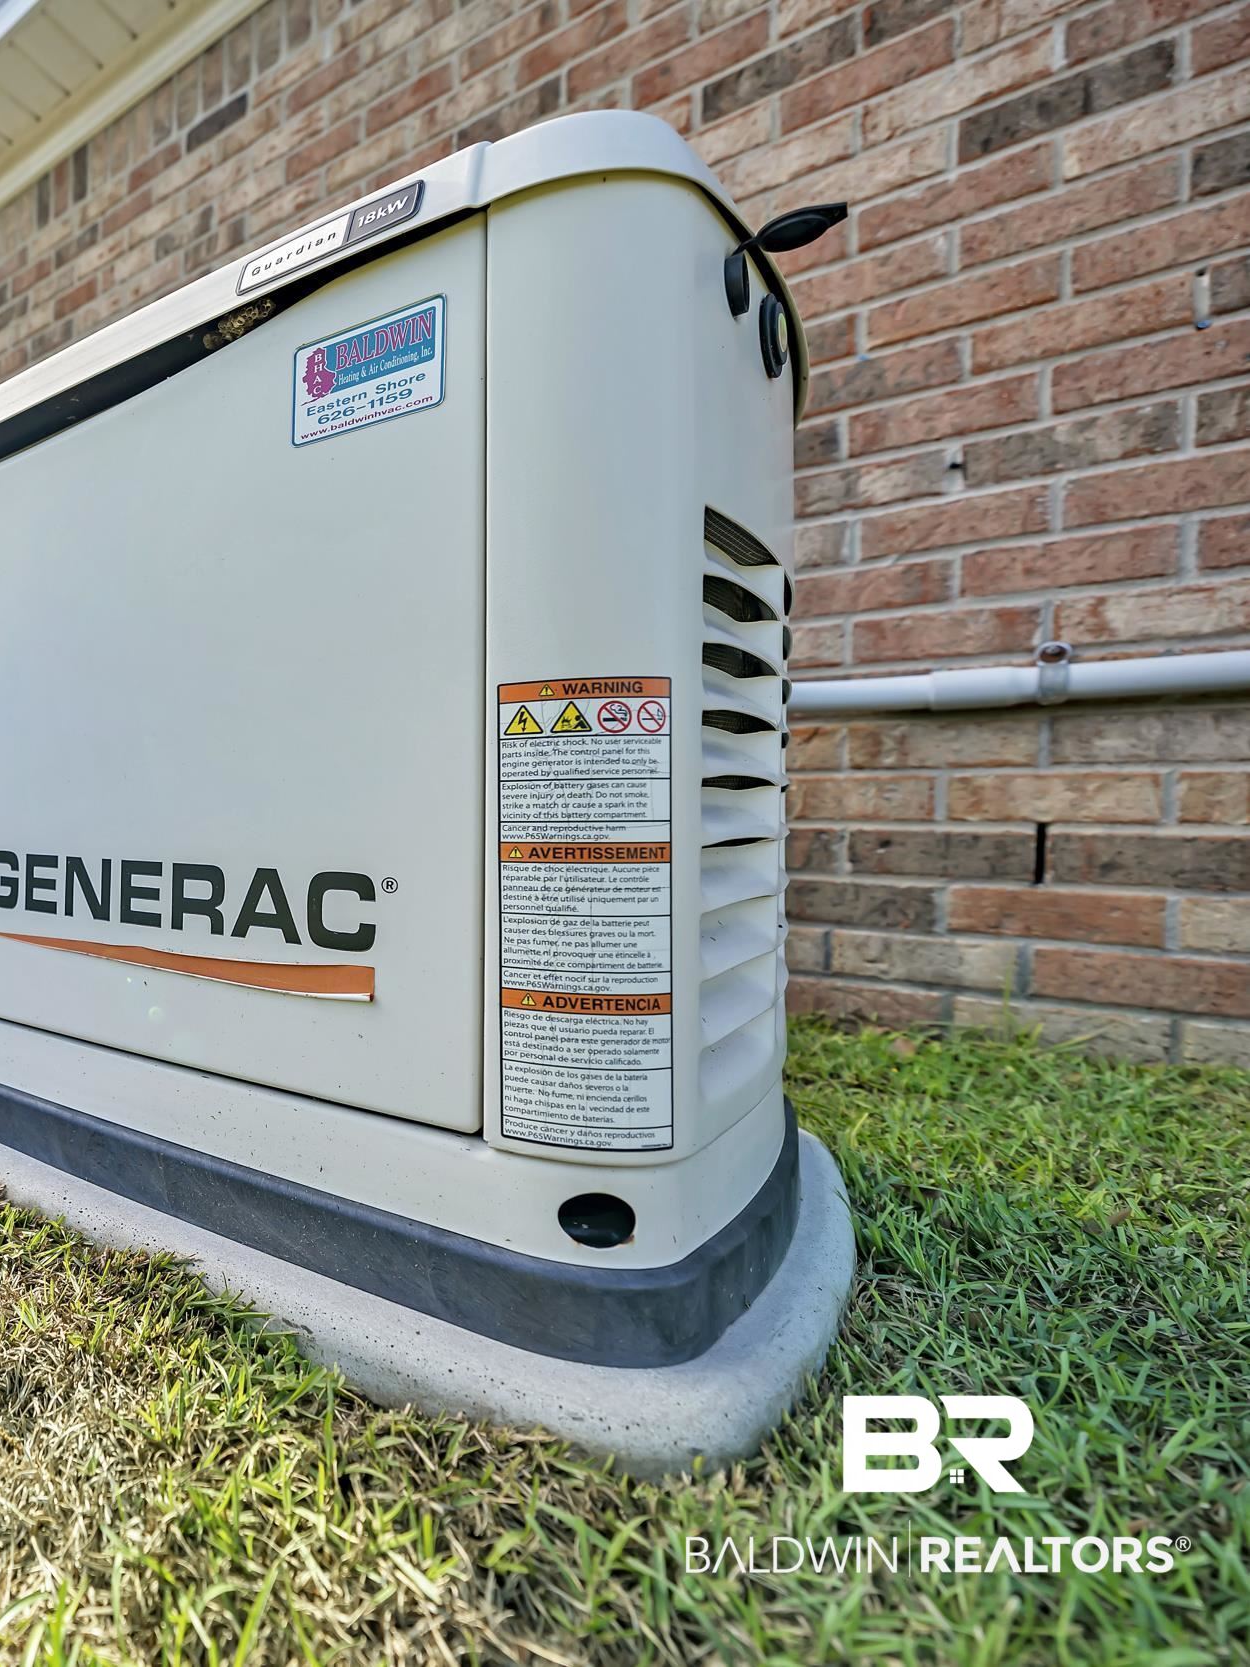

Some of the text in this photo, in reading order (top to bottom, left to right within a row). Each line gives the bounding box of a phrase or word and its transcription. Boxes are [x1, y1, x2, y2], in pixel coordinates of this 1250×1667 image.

[251, 195, 408, 276] Guardian 18kW
[335, 310, 435, 371] BALDWIN
[338, 344, 433, 386] Heating & Air Conditioning, Inc.
[306, 372, 426, 417] Eastern Shore
[317, 388, 413, 426] 626-1159
[300, 395, 433, 440] www.baldwinhvac.com
[562, 681, 643, 694] WARNING
[501, 741, 518, 749] Risk
[562, 738, 589, 746] shock.
[501, 751, 522, 760] parts
[501, 760, 530, 768] engine
[531, 759, 573, 768] generator
[501, 768, 539, 778] operated
[540, 768, 551, 776] by
[553, 767, 590, 776] qualified
[501, 783, 541, 791] Explosion
[553, 782, 585, 790] battery
[529, 792, 554, 800] injury
[532, 801, 559, 809] match
[501, 812, 531, 820] vicinity
[561, 811, 592, 820] battery
[549, 824, 604, 833] reproductive
[528, 847, 666, 859] AVERTISSEMENT
[502, 864, 530, 873] Risque
[502, 874, 541, 882] réparable
[502, 884, 539, 892] panneau
[502, 892, 533, 900] destiné
[503, 916, 548, 925] L'explosion
[548, 928, 588, 936] blessures
[503, 936, 515, 944] Ne
[516, 938, 531, 946] pas
[503, 947, 542, 955] allumette
[553, 951, 596, 959] provoquer
[503, 958, 542, 966] proximité
[503, 970, 532, 979] Cancer
[543, 996, 661, 1010] ADVERTENCIA
[503, 1010, 531, 1020] Riesgo
[545, 1014, 584, 1025] descarga
[503, 1020, 529, 1028] piezas
[559, 1026, 590, 1034] usuario
[504, 1030, 533, 1039] control
[534, 1034, 559, 1042] panel
[560, 1036, 580, 1044] para
[522, 1041, 565, 1052] destinado
[519, 1052, 556, 1062] personal
[567, 1070, 579, 1078] los
[504, 1075, 529, 1083] puede
[530, 1078, 556, 1087] causar
[504, 1085, 535, 1094] muerte.
[513, 1095, 533, 1106] haga
[534, 1099, 565, 1110] chispas
[504, 1105, 569, 1119] compartimiento
[505, 1119, 539, 1130] Produce
